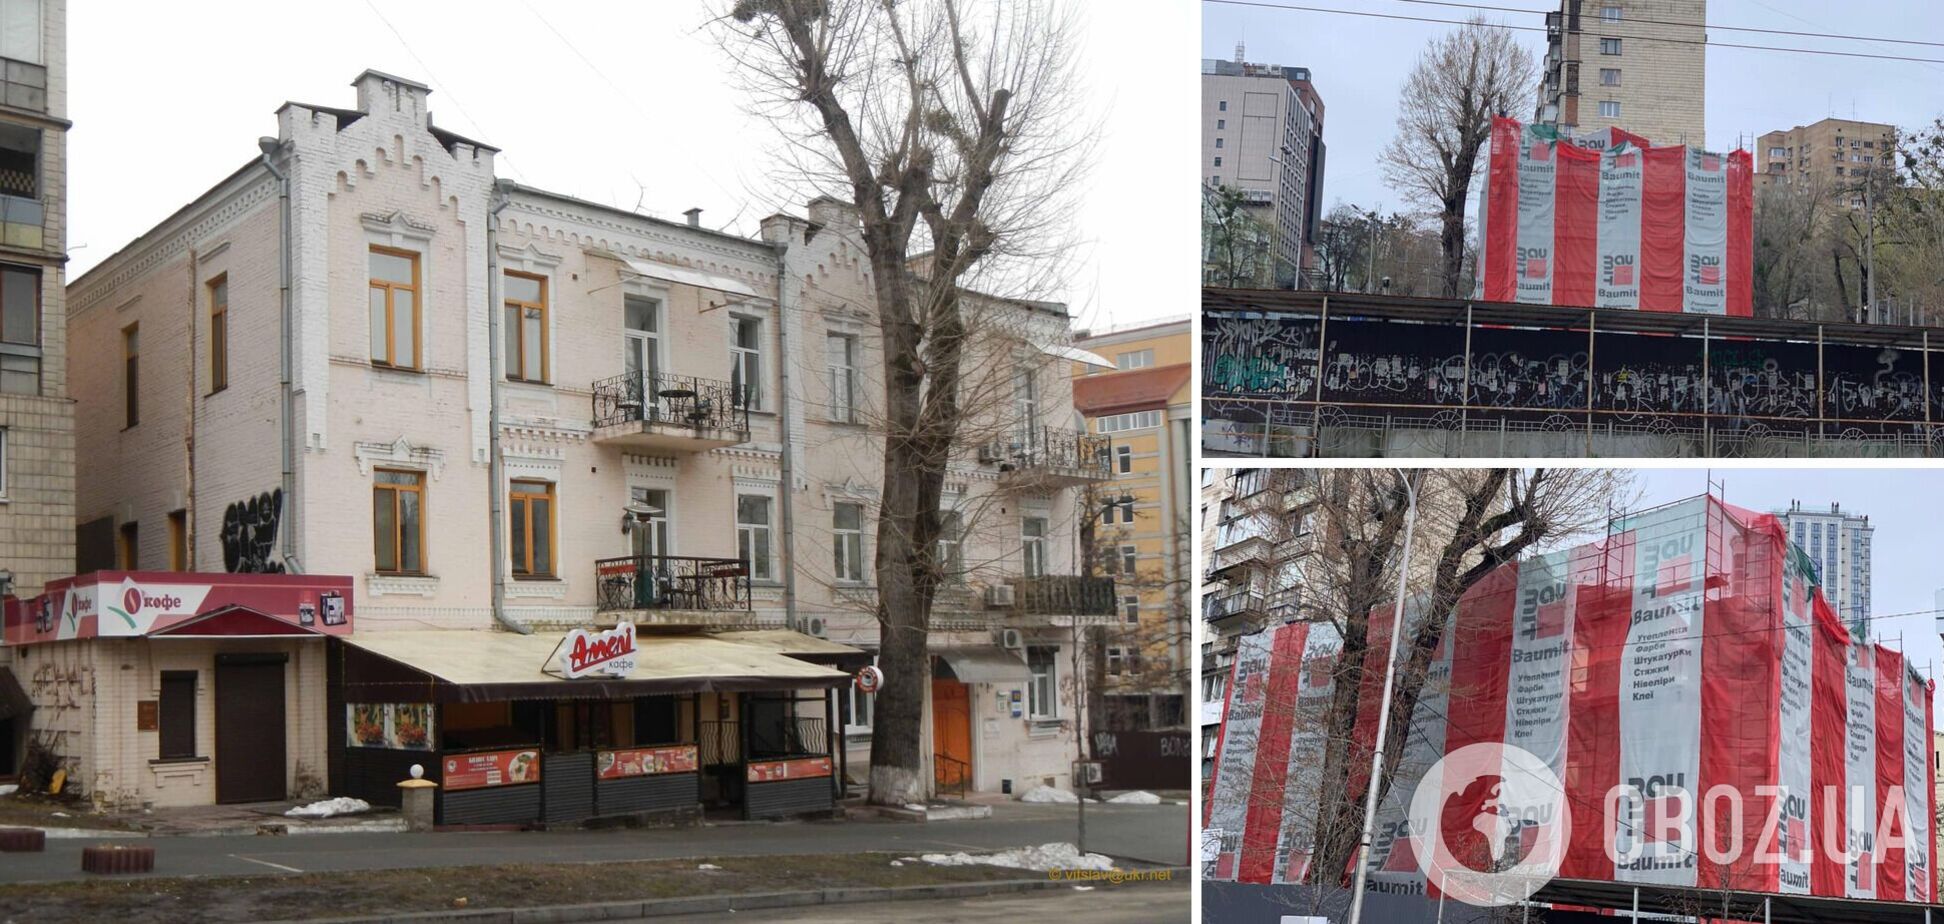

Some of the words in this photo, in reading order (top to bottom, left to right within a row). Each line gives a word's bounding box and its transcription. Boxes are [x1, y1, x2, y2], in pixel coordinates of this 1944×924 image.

[1602, 171, 1640, 180] Baumit
[1688, 172, 1724, 183] Baumit
[1517, 282, 1550, 291] aumit
[1687, 286, 1725, 297] Baumit
[1598, 288, 1637, 298] Baumit
[144, 594, 181, 611] кофе
[1513, 640, 1569, 663] Baumit
[1635, 643, 1666, 653] Фарби
[1633, 648, 1692, 665] Штукатурки
[609, 658, 633, 671] кафе
[1633, 665, 1670, 677] Стяжки
[1633, 676, 1675, 690] Нівеліри
[1632, 691, 1654, 701] Клеї
[1781, 868, 1809, 889] aumit
[1367, 880, 1423, 896] aumit
